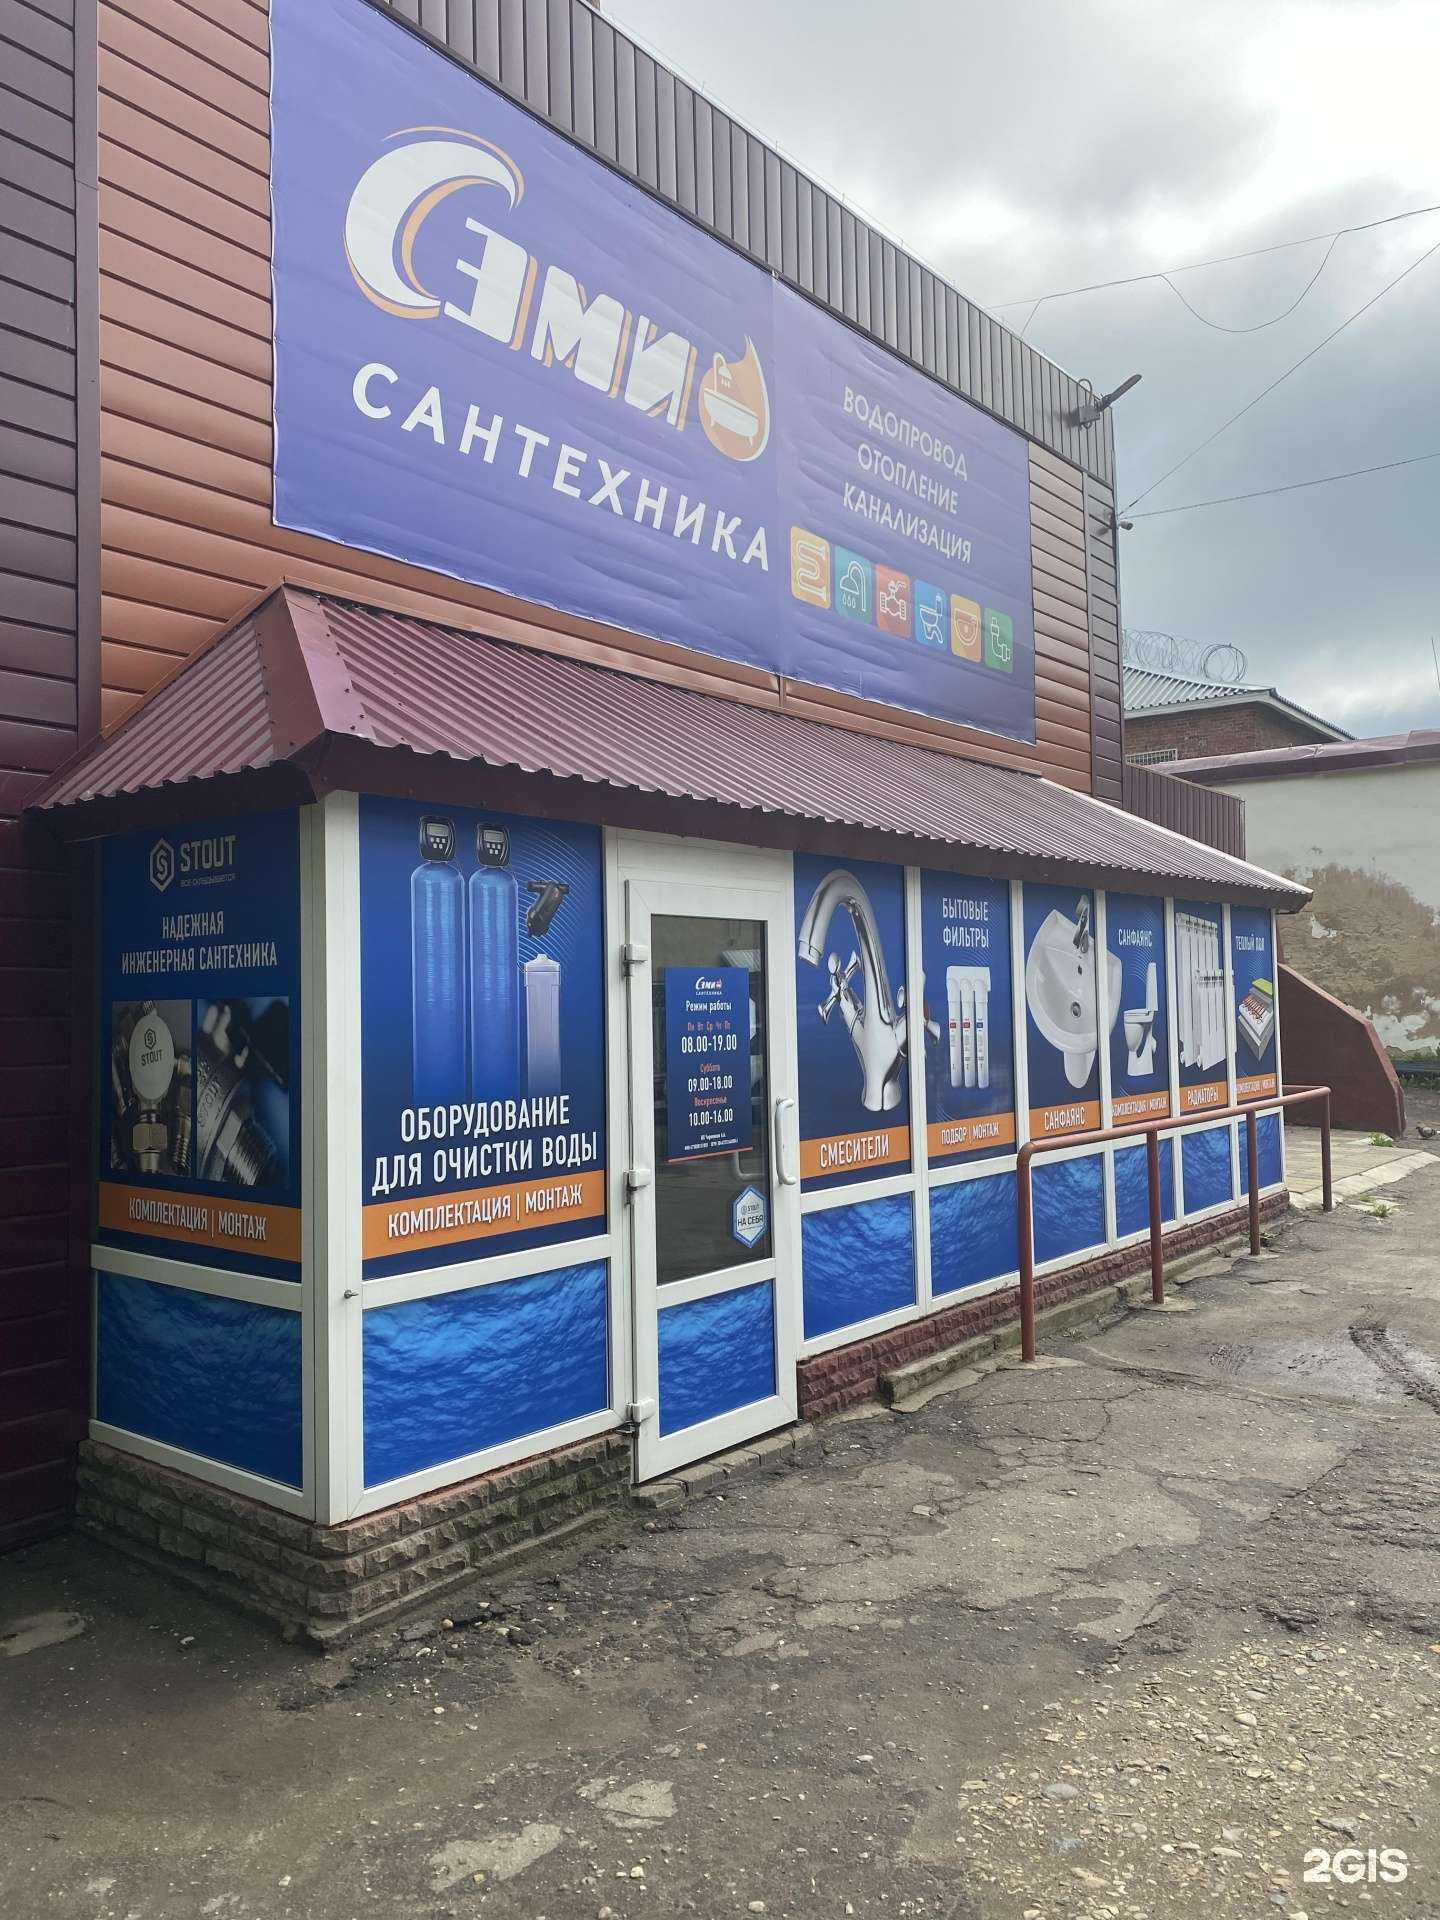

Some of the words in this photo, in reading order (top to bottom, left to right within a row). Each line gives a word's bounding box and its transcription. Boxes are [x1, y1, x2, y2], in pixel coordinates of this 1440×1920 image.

[843, 386, 968, 481] ВОДОПРОВОД
[352, 363, 769, 571] САНТЕХНИКА
[857, 443, 958, 514] ОТОПЛЕНИЕ
[843, 483, 972, 564] КАНАЛИЗАЦИЯ
[180, 835, 236, 872] STOUT
[942, 898, 989, 921] БЫТОВЫЕ
[162, 911, 224, 940] НАДЕЖНАЯ
[943, 927, 989, 948] ФИЛЬТРЫ
[1118, 928, 1153, 946] САНФАЯНС
[122, 948, 195, 974] ИНЖЕНЕРНАЯ
[200, 941, 278, 970] САНТЕХНИКА
[686, 1001, 708, 1012] Режим
[709, 1000, 732, 1014] работы
[681, 1034, 737, 1053] 08.00-19.00
[688, 1075, 733, 1092] 09.00-18.00
[1187, 1087, 1219, 1105] РАДИАТОРЫ
[401, 1095, 570, 1143] ОБОРУДОВАНИЕ
[689, 1108, 733, 1127] 10.00-16.00
[1044, 1106, 1086, 1131] САНФАЯНС
[941, 1126, 967, 1145] ПОДБОР
[972, 1122, 1000, 1139] МОНТАЖ
[372, 1152, 422, 1196] ДЛЯ
[433, 1139, 533, 1183] ОЧИСТКИ
[543, 1131, 597, 1168] ВОДЫ
[820, 1133, 889, 1168] СМЕСИТЕЛИ
[129, 1197, 208, 1231] КОМПЛЕКТАЦИЯ
[218, 1211, 267, 1241] МОНТАЖ
[388, 1196, 511, 1238] КОМПЛЕКТАЦИЯ
[525, 1184, 583, 1215] МОНТАЖ
